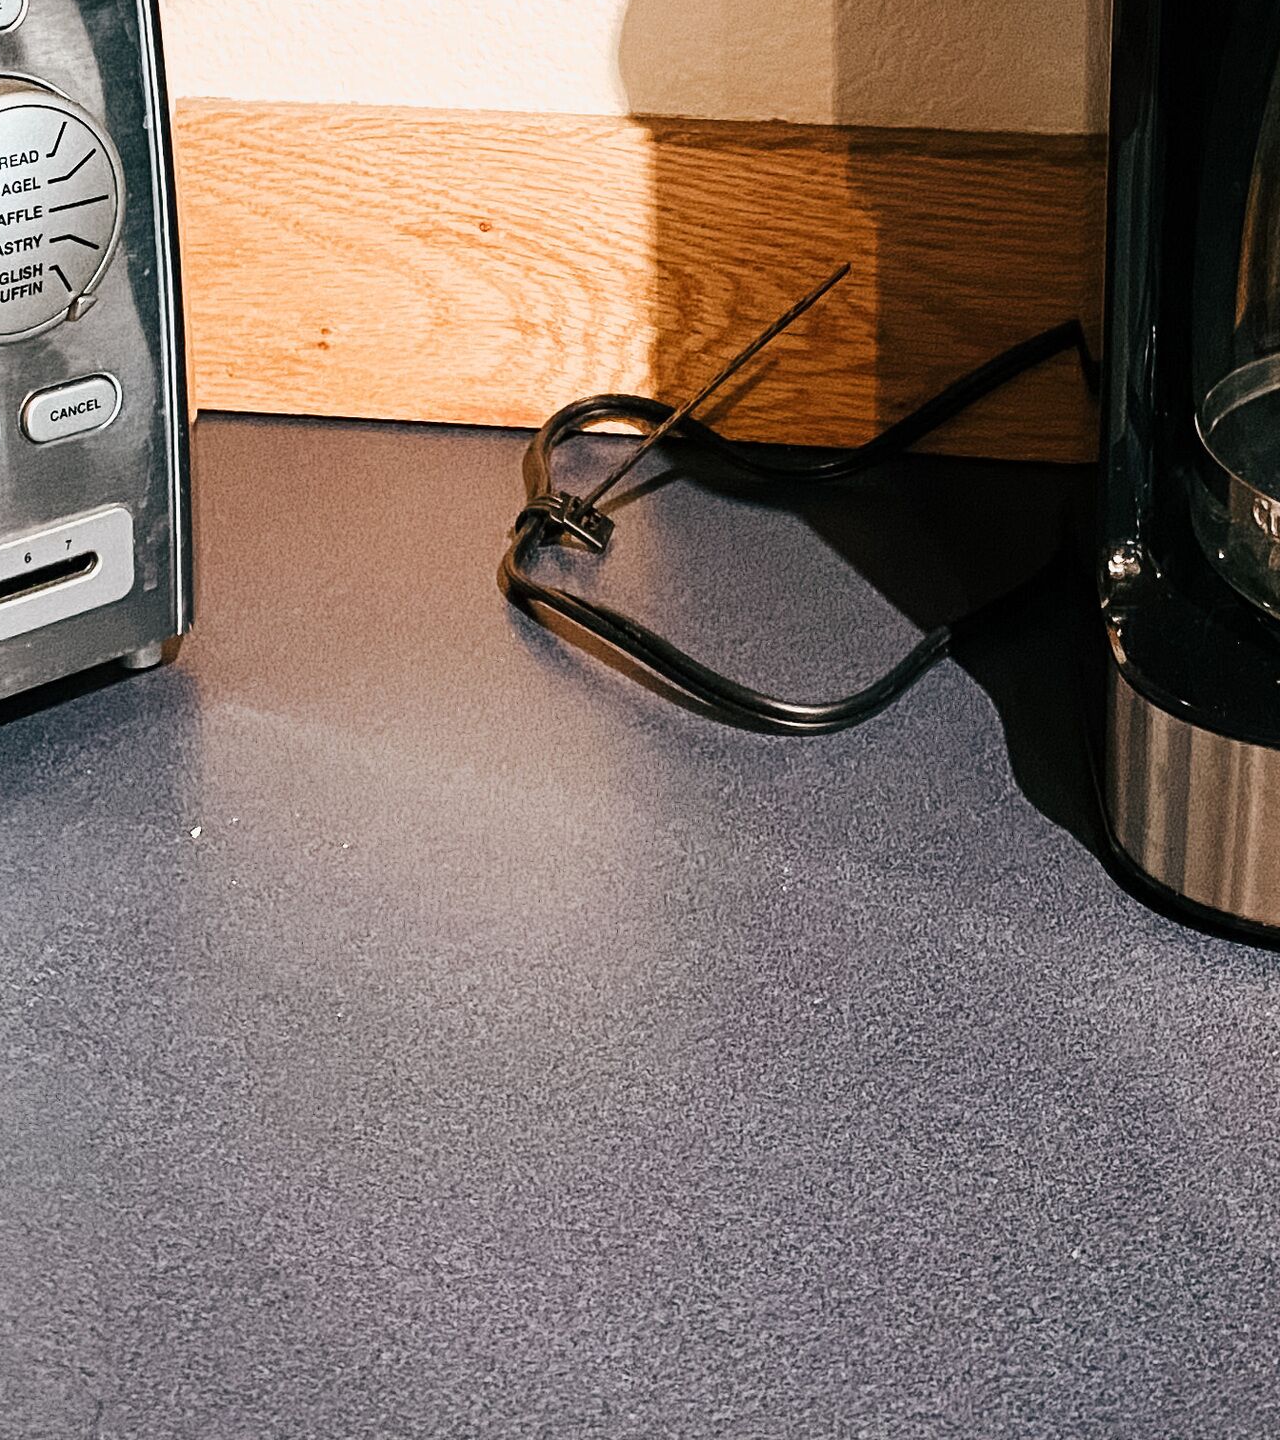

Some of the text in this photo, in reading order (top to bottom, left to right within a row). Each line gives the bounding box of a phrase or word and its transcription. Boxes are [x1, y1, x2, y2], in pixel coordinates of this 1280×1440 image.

[49, 398, 103, 423] CANCEL
[23, 552, 33, 564] 6
[64, 539, 73, 551] 7
